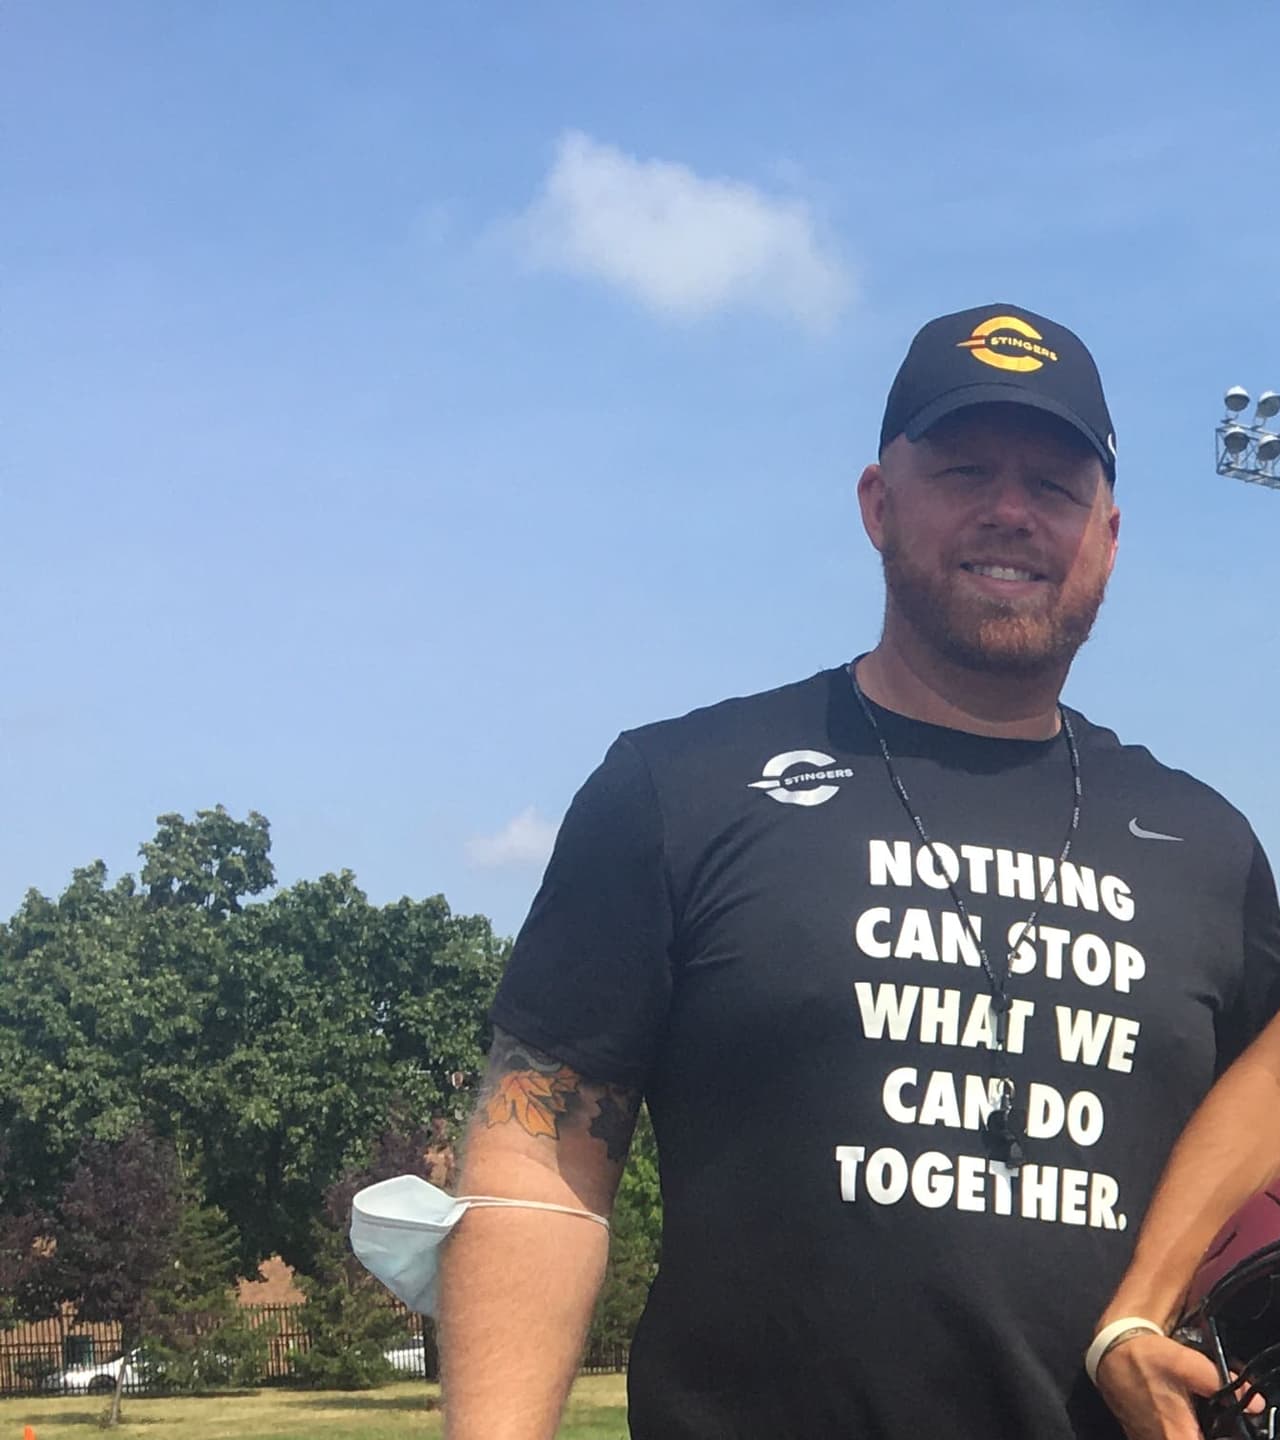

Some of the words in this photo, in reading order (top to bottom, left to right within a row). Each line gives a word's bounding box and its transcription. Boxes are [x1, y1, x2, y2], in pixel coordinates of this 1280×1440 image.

[990, 336, 1058, 361] STINGERS
[783, 768, 855, 785] STINGERS
[868, 840, 1136, 923] NOTHING
[854, 907, 982, 969] CAN
[1007, 921, 1146, 995] STOP
[853, 981, 1035, 1055] WHAT
[1055, 1005, 1141, 1074] WE
[881, 1066, 1006, 1132] CAN
[1025, 1083, 1105, 1148] DO
[835, 1145, 1128, 1232] TOGETHER.
